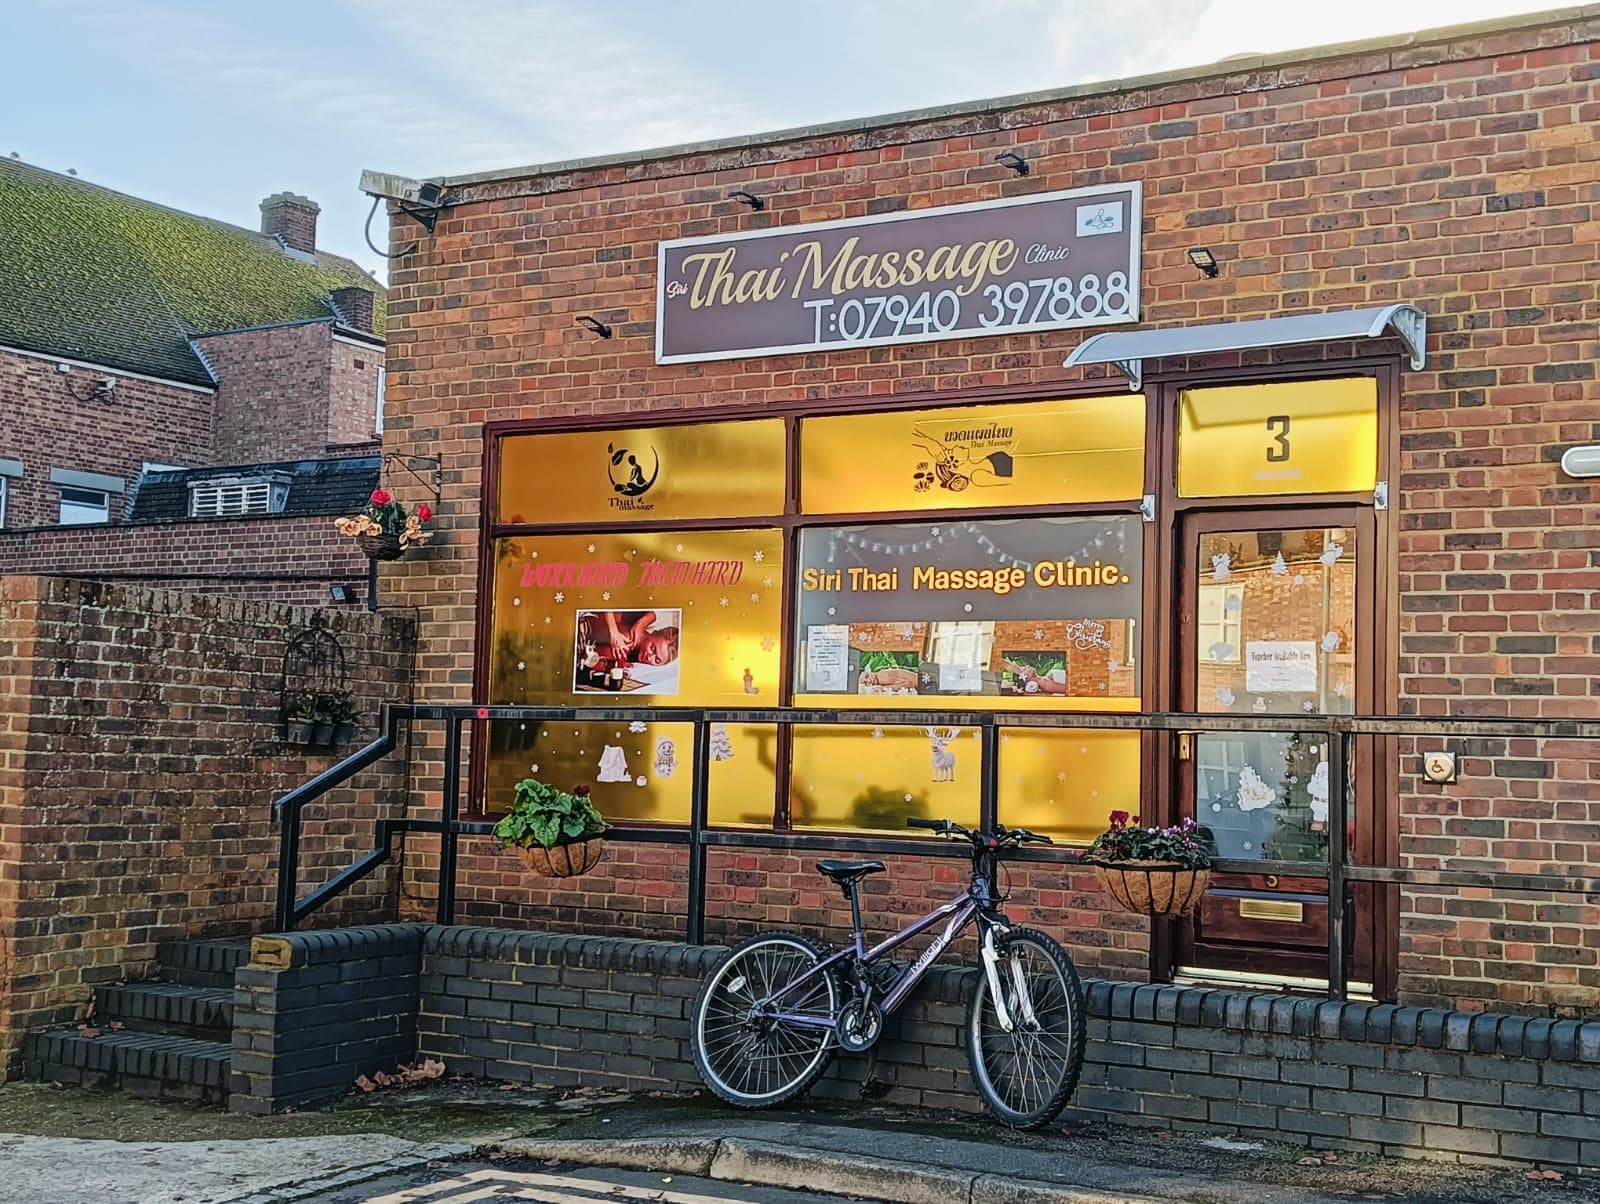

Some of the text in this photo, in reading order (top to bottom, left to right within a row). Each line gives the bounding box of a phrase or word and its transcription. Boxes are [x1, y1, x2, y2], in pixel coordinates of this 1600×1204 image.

[681, 247, 785, 309] Thai
[791, 237, 1019, 297] Massage
[1025, 244, 1069, 263] Clinic
[803, 271, 1130, 344] T:07940 397888
[1266, 415, 1290, 462] 3
[608, 496, 634, 507] Thai
[618, 503, 655, 511] massage
[802, 561, 1130, 595] Siri Thai Massage Clinic.
